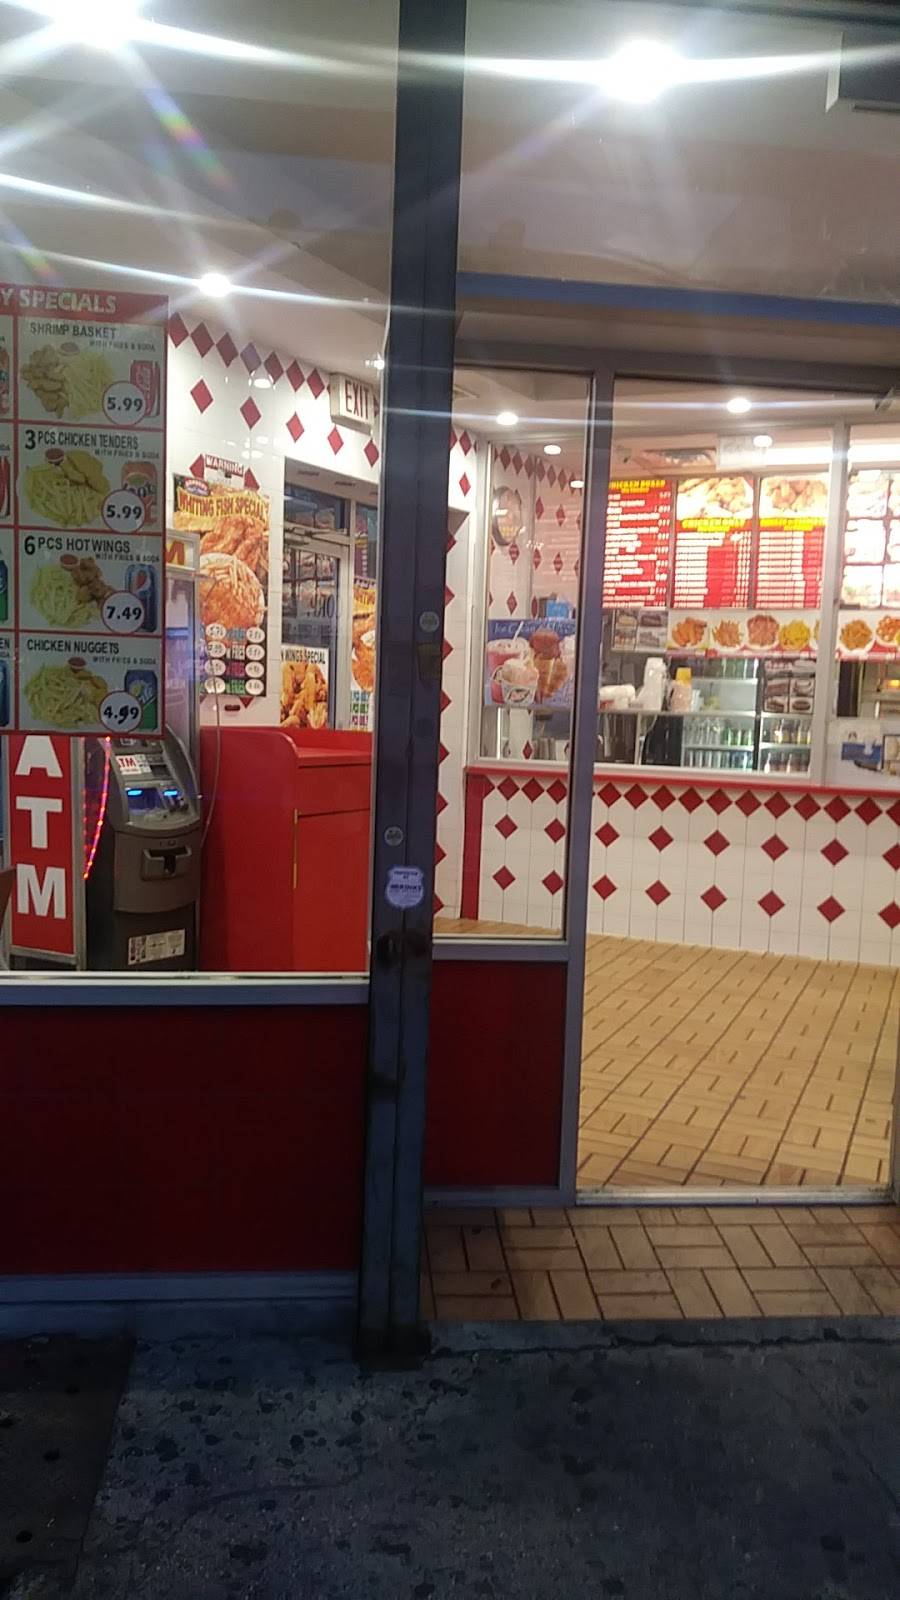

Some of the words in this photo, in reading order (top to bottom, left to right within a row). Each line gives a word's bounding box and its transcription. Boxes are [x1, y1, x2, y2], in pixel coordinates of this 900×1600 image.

[19, 288, 117, 313] SPECIALS
[30, 321, 69, 336] SHRIMP
[72, 323, 117, 339] BASKET
[107, 397, 144, 412] 5.99
[344, 379, 370, 420] EXIT
[24, 429, 36, 450] 3
[38, 430, 56, 445] PCS
[58, 431, 97, 447] CHICKEN
[99, 433, 139, 450] TENDERS
[106, 504, 142, 519] 5.99
[24, 535, 36, 555] 6
[38, 536, 63, 550] PCS
[66, 537, 91, 551] HOT
[91, 538, 130, 553] WINGS
[106, 605, 142, 620] 7.49
[27, 639, 71, 653] CHICKEN
[73, 640, 120, 654] NUGGETS
[15, 735, 67, 919] ATM
